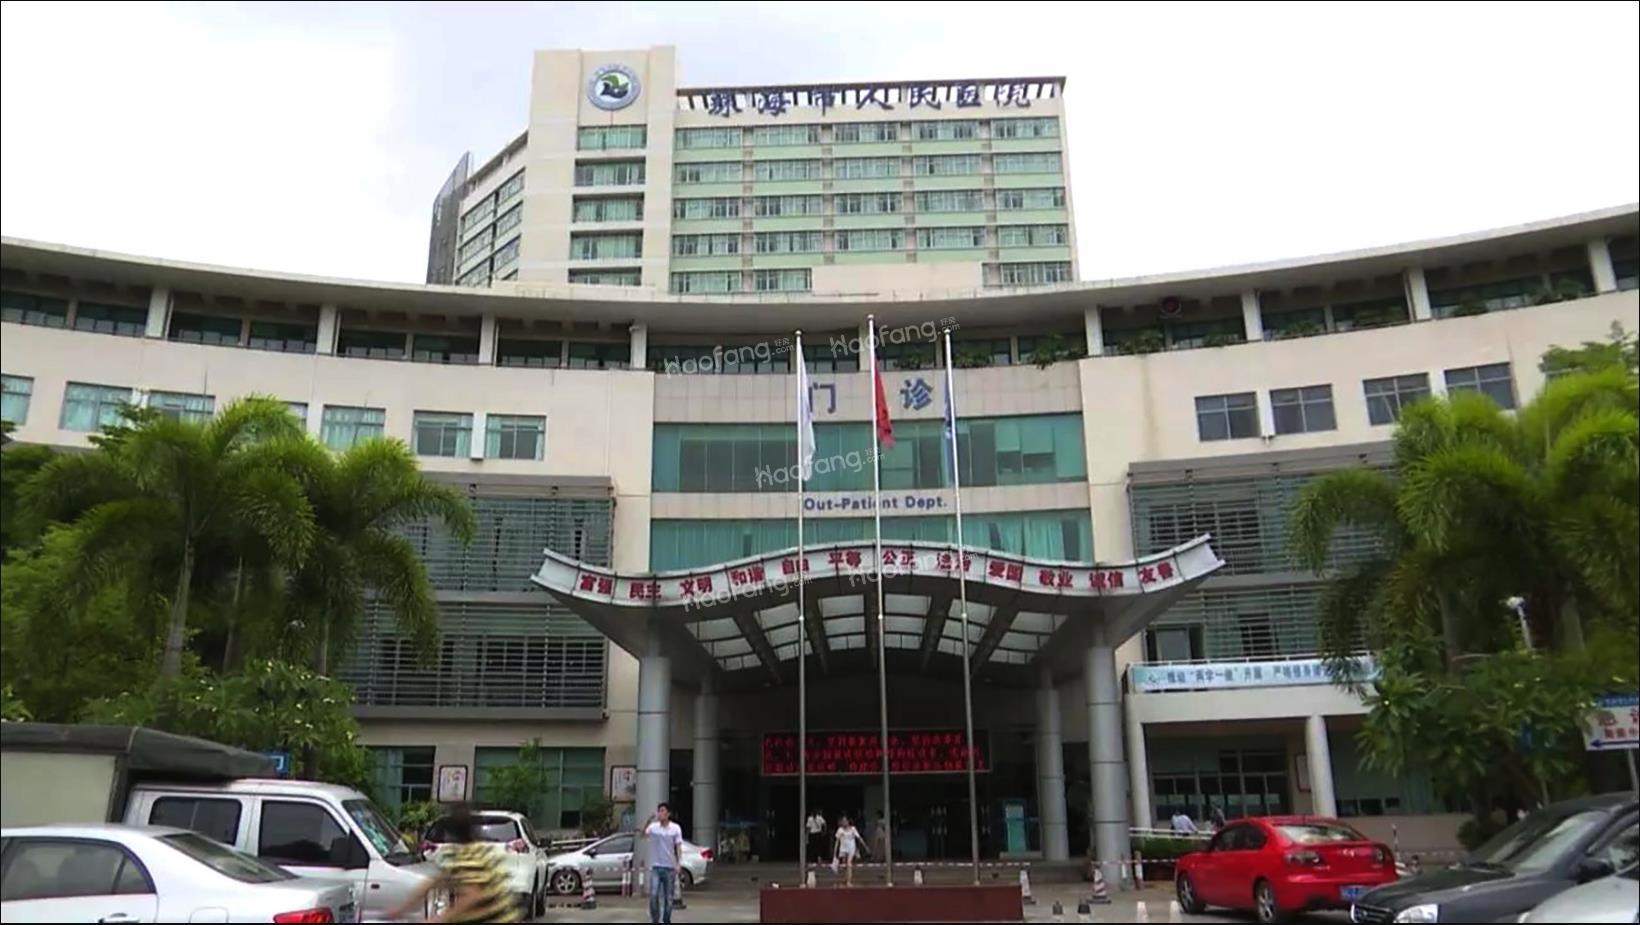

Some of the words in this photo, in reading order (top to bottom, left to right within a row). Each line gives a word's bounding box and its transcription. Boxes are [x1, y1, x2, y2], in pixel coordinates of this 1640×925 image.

[707, 84, 1032, 117] 珠海市人民医院
[808, 378, 933, 414] 门诊
[905, 495, 947, 510] Dept.
[580, 574, 612, 595] 富强
[629, 581, 662, 599] 民主
[680, 575, 713, 596] 文明
[730, 564, 765, 586] 和谐
[782, 557, 810, 575] 自由
[828, 549, 861, 569] 平等
[883, 549, 916, 567] 公正
[987, 560, 1025, 582] 爱国
[1038, 569, 1074, 588] 敬业
[1089, 571, 1124, 589] 诚信
[1138, 561, 1174, 583] 友善
